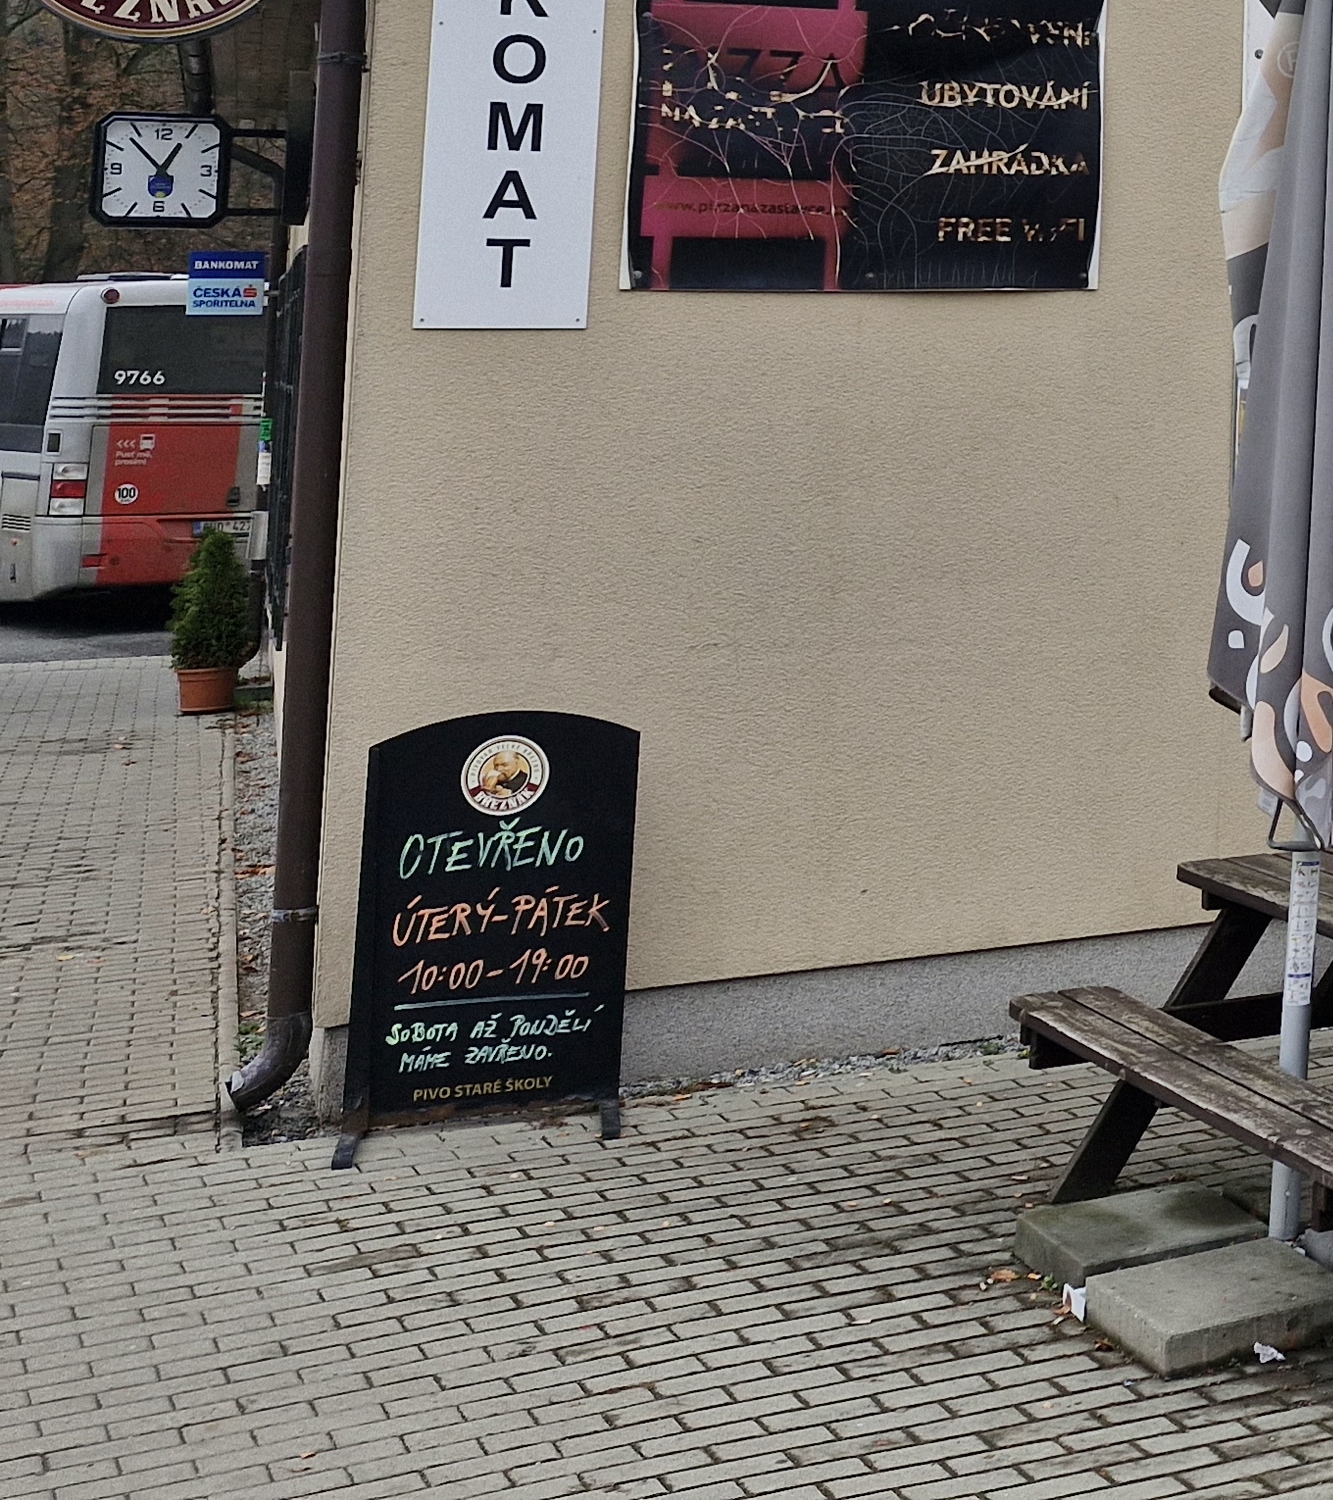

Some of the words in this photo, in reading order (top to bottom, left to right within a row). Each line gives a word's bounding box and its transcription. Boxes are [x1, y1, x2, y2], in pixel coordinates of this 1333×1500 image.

[919, 80, 1092, 111] UBYTOVÁNÍ
[154, 128, 174, 141] 12
[925, 146, 1090, 176] ZAHRÁDKA
[937, 217, 1013, 242] FREE
[193, 260, 260, 270] BANKOMAT
[192, 284, 242, 298] ČESKÁ
[113, 369, 166, 386] 9766
[116, 486, 136, 499] 100
[399, 816, 585, 880] OTEVŘENO
[385, 1021, 459, 1046] SOBOTA
[469, 1012, 503, 1039] AŽ
[509, 1004, 605, 1038] PONDĚLÍ
[398, 1045, 452, 1074] MÁME
[413, 1086, 451, 1102] PIVO
[454, 1078, 502, 1098] STARÉ
[504, 1075, 553, 1093] ŠKOLY
